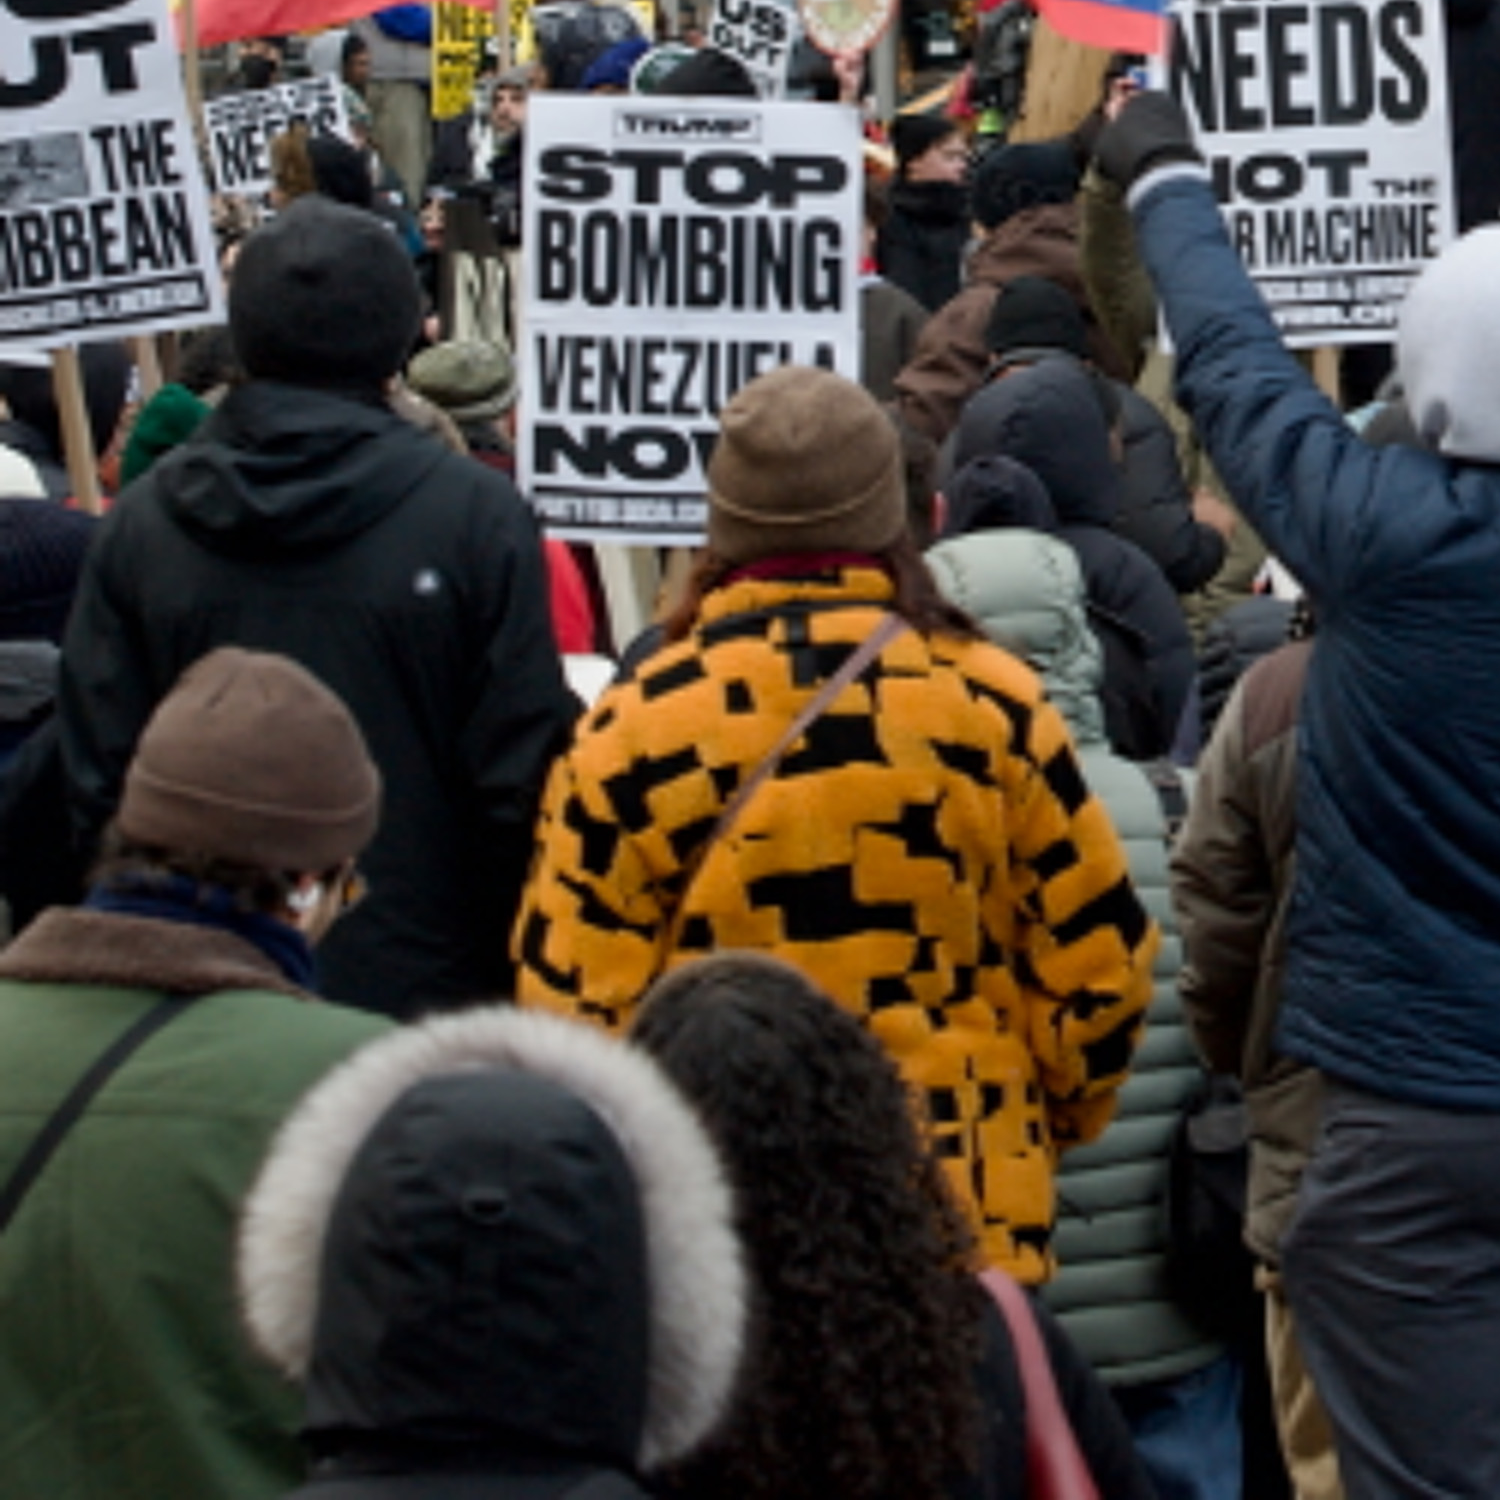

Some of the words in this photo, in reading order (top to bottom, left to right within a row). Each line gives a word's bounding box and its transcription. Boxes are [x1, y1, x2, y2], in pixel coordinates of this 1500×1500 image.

[89, 119, 183, 193] THE
[621, 112, 752, 137] TRUMP
[537, 146, 849, 210] STOP
[1371, 176, 1437, 199] THE
[537, 208, 843, 313] BOMBING
[1264, 203, 1438, 266] MACHINE
[536, 334, 836, 416] VENEZU
[533, 423, 719, 481] NO
